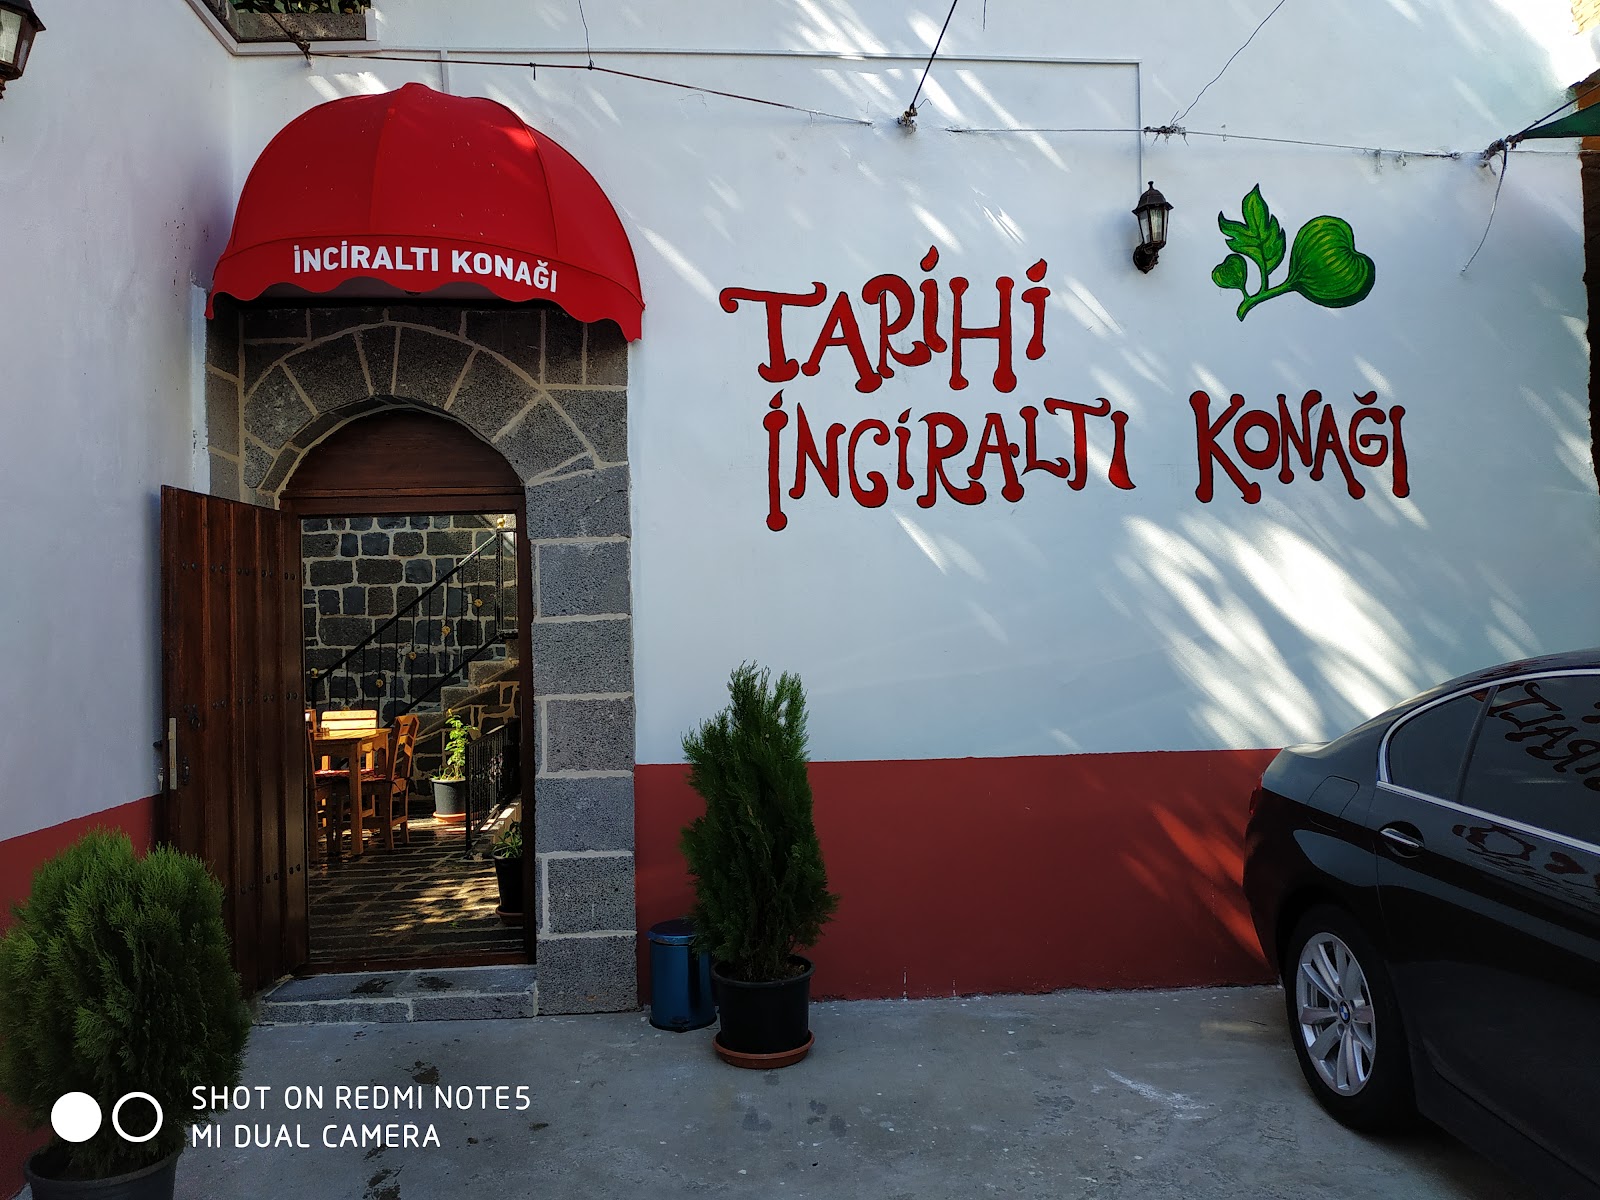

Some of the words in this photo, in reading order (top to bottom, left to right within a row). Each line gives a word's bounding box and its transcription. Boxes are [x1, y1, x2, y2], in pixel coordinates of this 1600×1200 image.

[294, 241, 438, 273] İNCİRALTI
[452, 250, 556, 292] KONAĞI
[1189, 390, 1410, 504] KONAĞI
